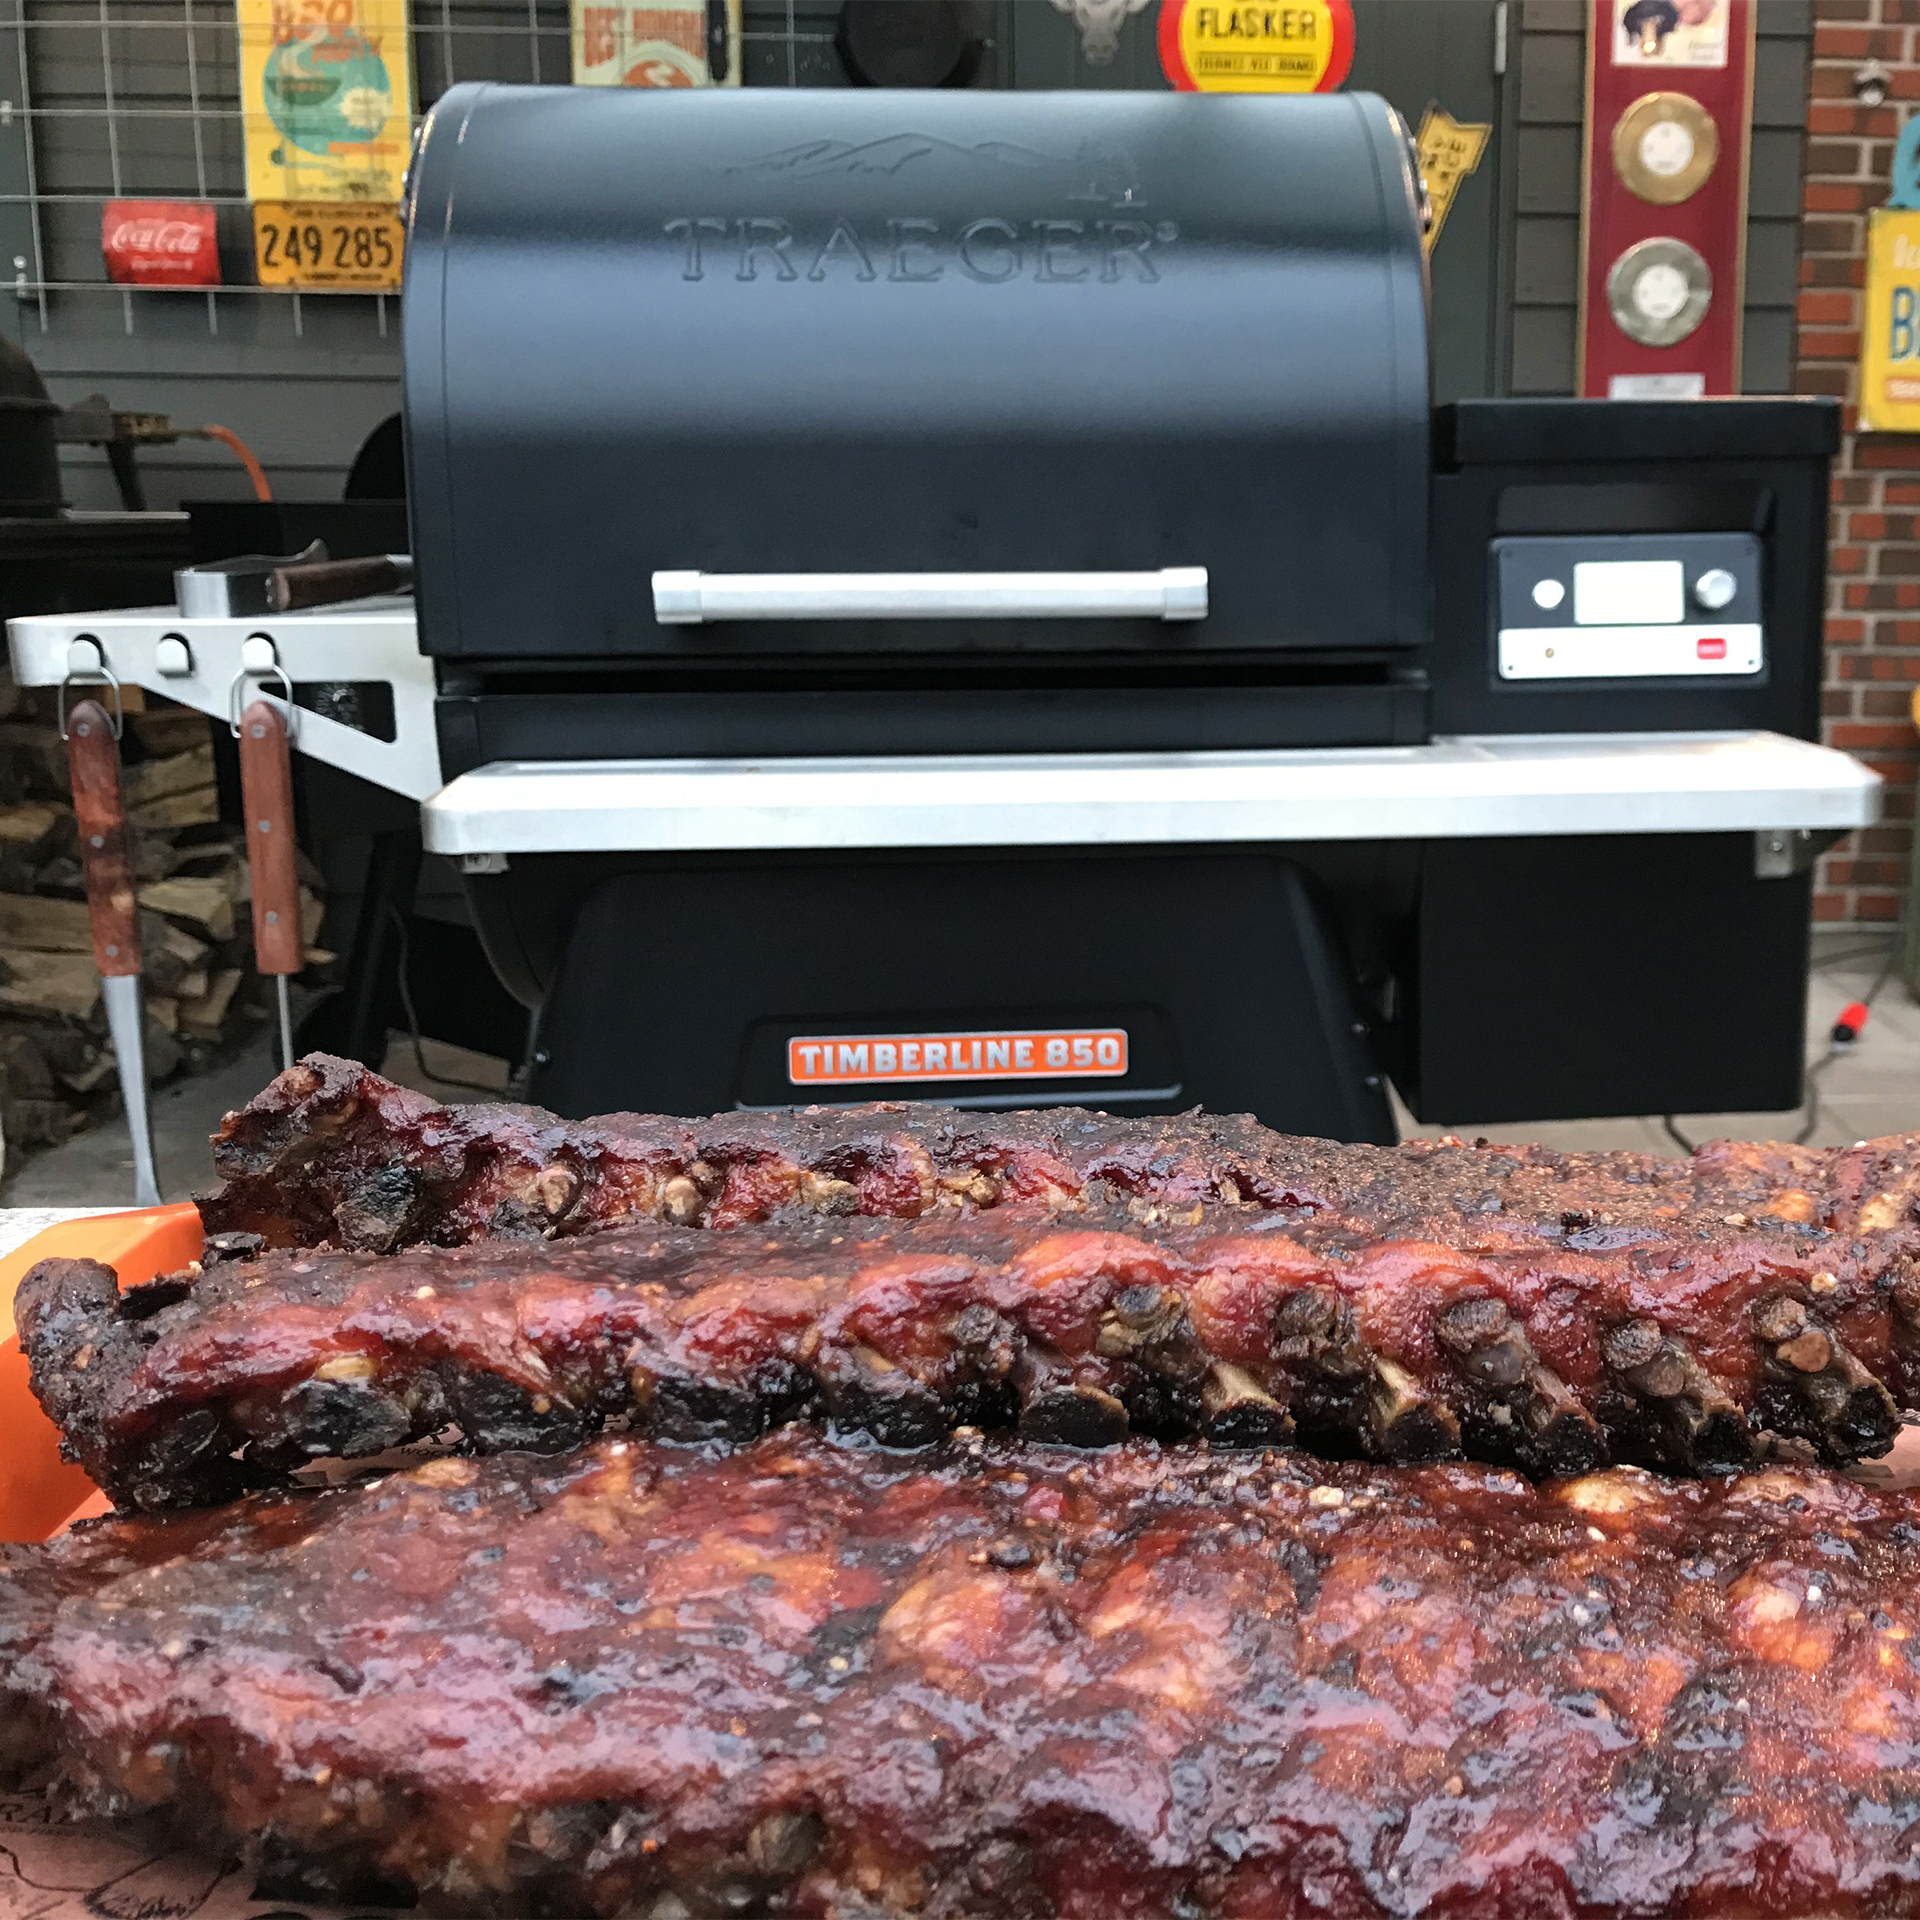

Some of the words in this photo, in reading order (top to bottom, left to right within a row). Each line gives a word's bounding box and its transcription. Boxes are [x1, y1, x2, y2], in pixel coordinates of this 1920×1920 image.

[1196, 7, 1317, 40] FLASKER
[261, 219, 322, 267] 249
[333, 220, 393, 268] 285
[799, 1039, 1035, 1076] TIMBERLINE
[1045, 1038, 1120, 1068] 850
